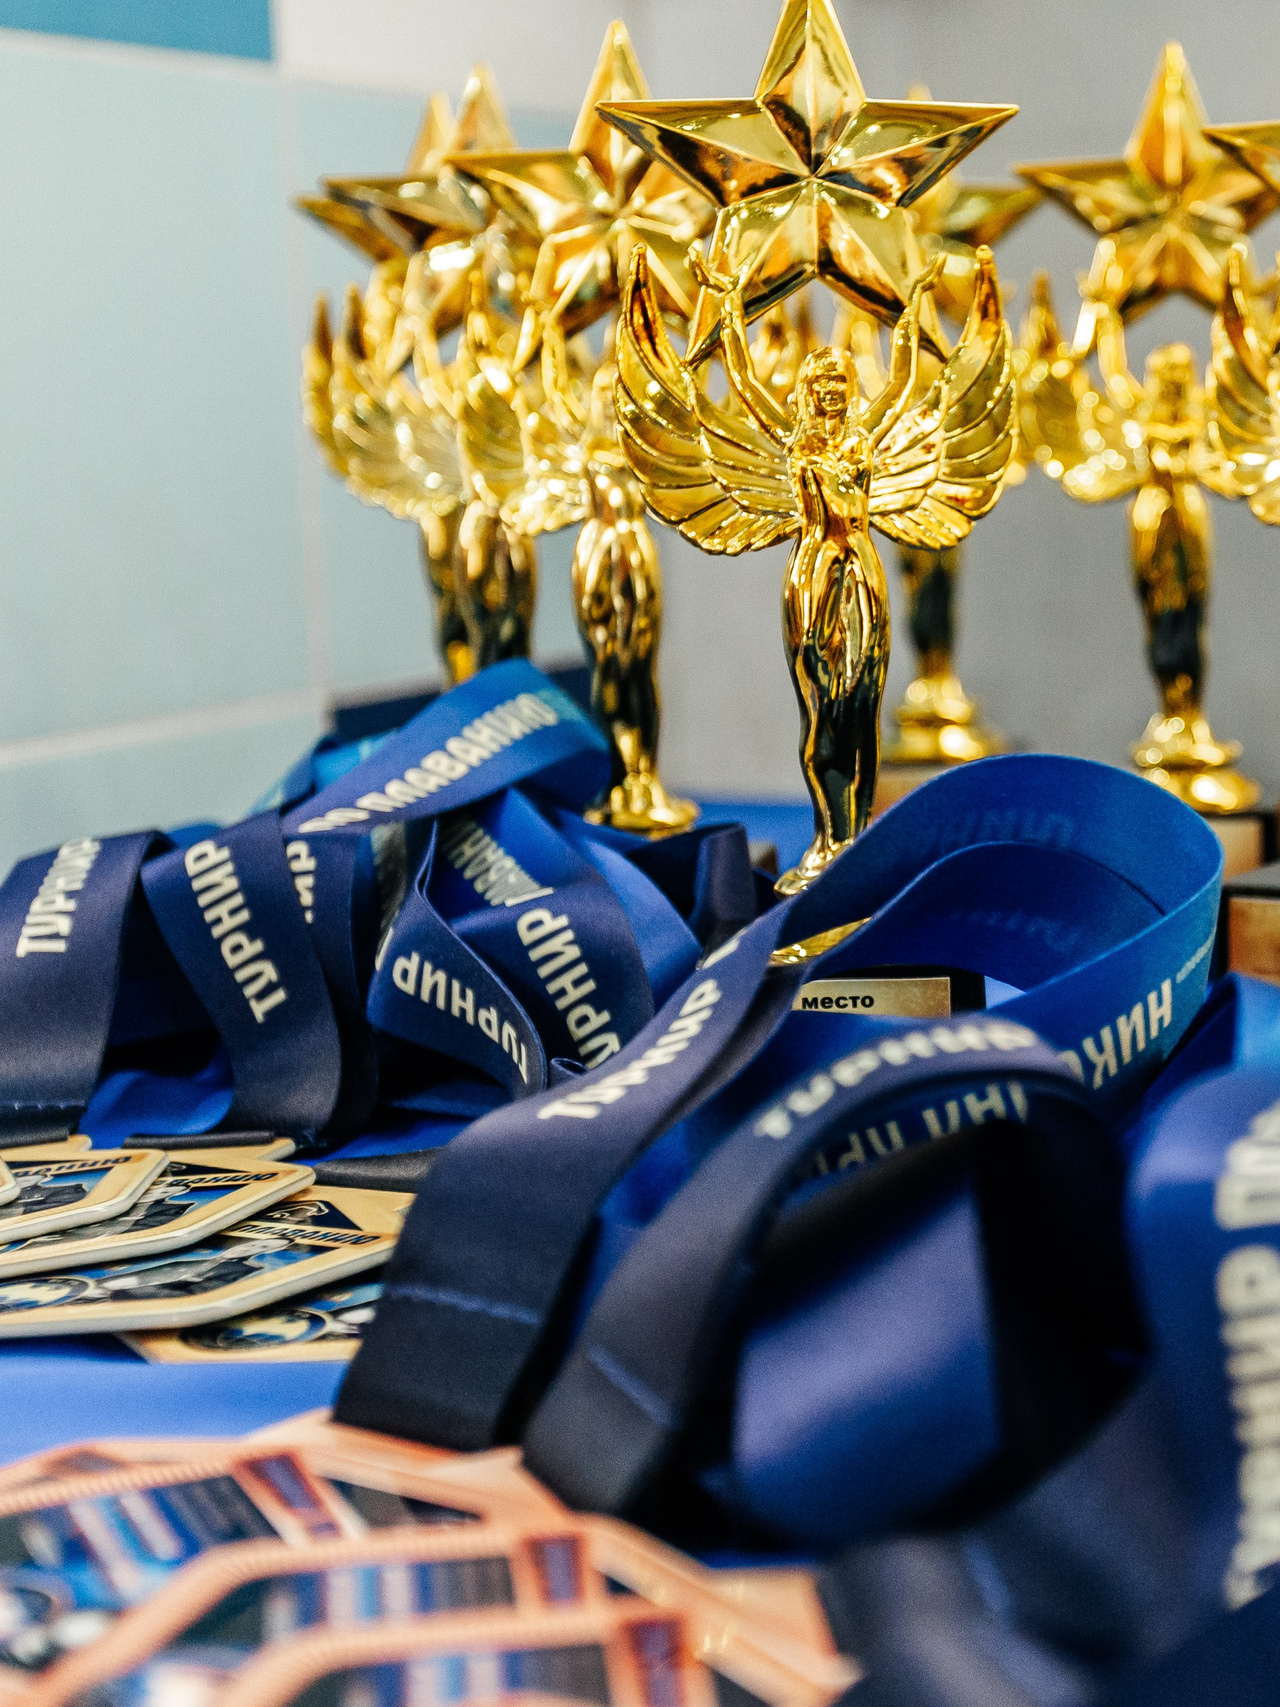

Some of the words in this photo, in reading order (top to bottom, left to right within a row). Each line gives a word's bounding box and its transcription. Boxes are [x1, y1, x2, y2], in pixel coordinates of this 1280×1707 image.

[15, 836, 102, 958] ТУРНИР
[184, 839, 288, 1024] ТУРНИР
[392, 951, 529, 1086] ТУРНИР
[516, 907, 622, 1069] УРНИР
[537, 978, 722, 1119] ТУРНИР
[801, 995, 874, 1010] место
